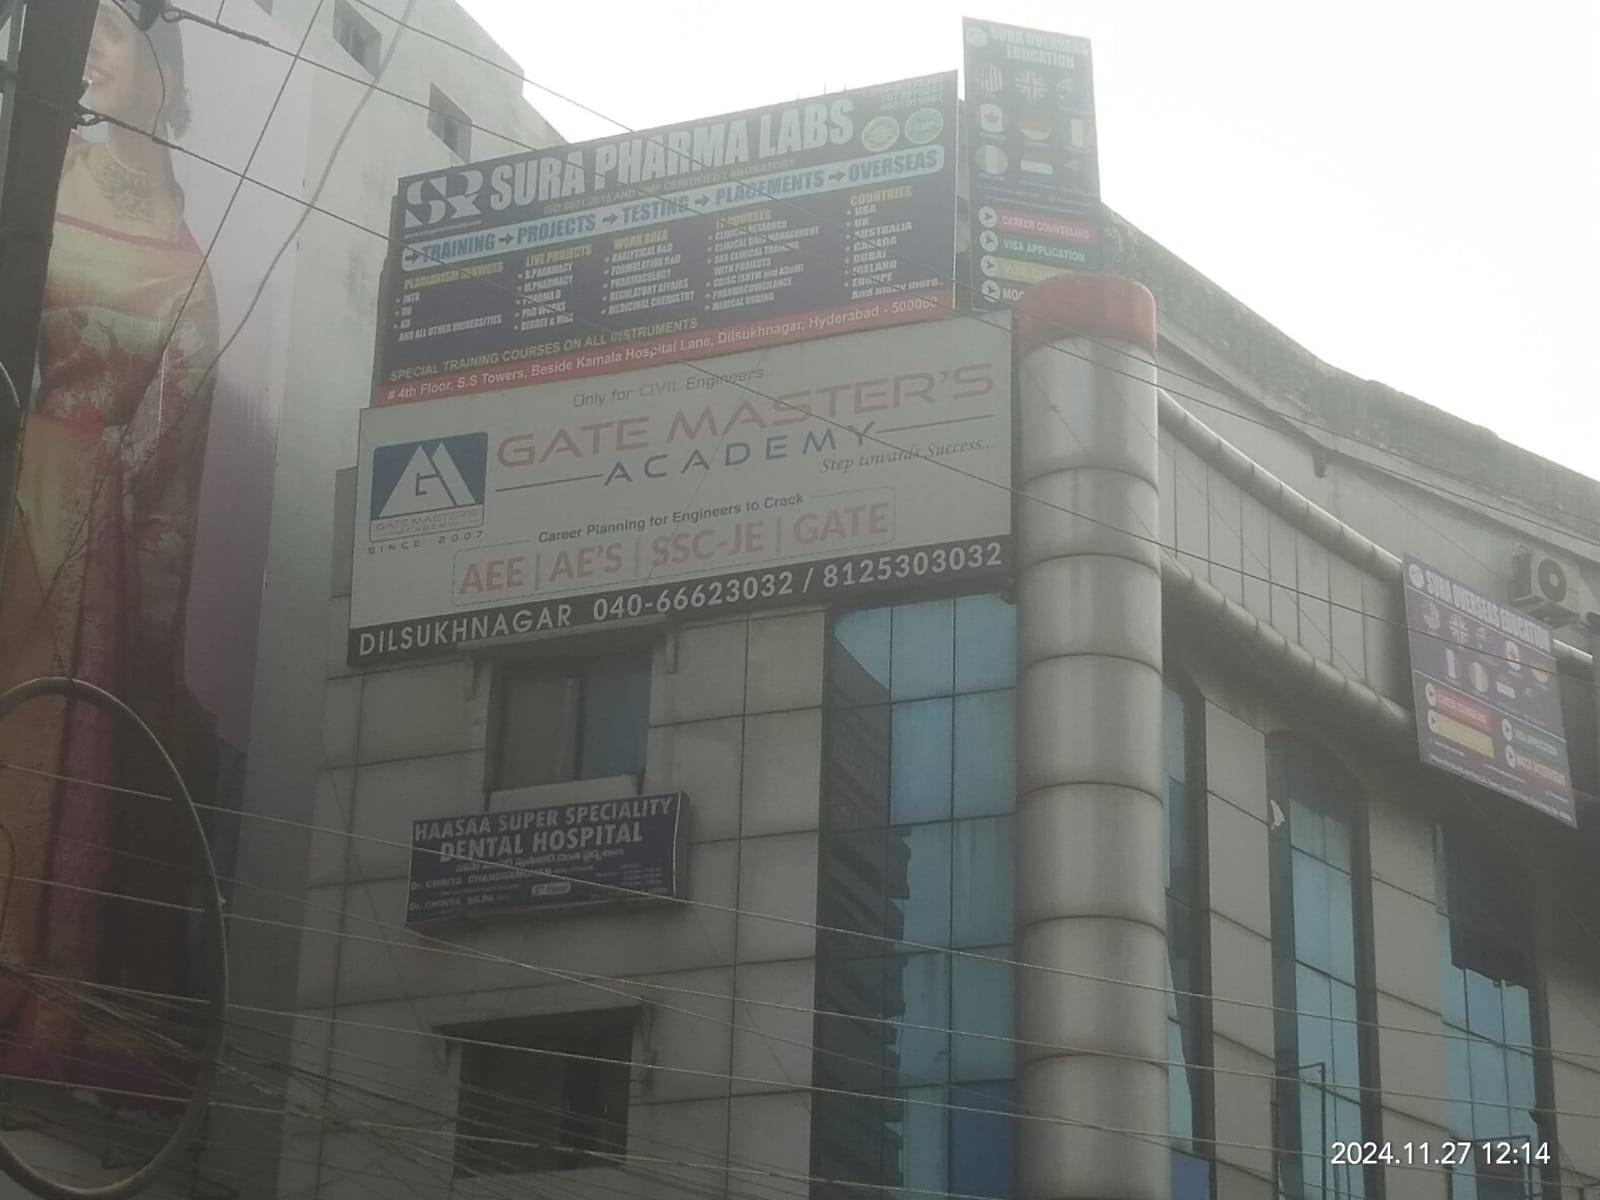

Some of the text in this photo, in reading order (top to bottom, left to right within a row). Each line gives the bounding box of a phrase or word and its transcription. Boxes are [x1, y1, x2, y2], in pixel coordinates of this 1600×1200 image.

[490, 151, 585, 210] SURA
[594, 119, 749, 192] PHARMA
[759, 98, 854, 158] LABS
[423, 233, 496, 263] TRAINING
[517, 213, 597, 246] PROJECTS
[623, 195, 689, 224] TESTING
[716, 169, 824, 206] PLACEMENTS
[849, 150, 937, 182] OVERSEAS
[850, 185, 912, 206] COUNTRIES
[855, 204, 876, 216] USA
[854, 221, 913, 239] AUSTRALIA
[855, 217, 869, 228] UK
[1002, 216, 1035, 230] CAREER
[853, 250, 886, 264] DUBAI
[1003, 239, 1085, 263] VISA APPLICATION
[1002, 287, 1025, 301] MOC
[390, 318, 698, 382] SPECIAL TRAINING COURSES ON ALL INSTRUMENTS
[457, 374, 478, 389] S.S
[482, 369, 528, 384] Towers,
[530, 360, 573, 376] Beside
[577, 352, 623, 369] Kamala
[625, 340, 677, 362] Hospital
[718, 320, 806, 344] Dilsukhnagar,
[809, 304, 880, 329] Hyderabad
[573, 366, 765, 409] Only for CIVIL Engineers
[497, 361, 995, 469] GATE MASTER'S
[603, 420, 877, 487] ACADEMY
[821, 457, 854, 474] Step
[858, 444, 922, 466] towards
[538, 493, 804, 544] Career Planning for Engineers to Crack
[367, 530, 484, 555] SINCE 2007
[459, 502, 889, 594] AEE AE'S SSC-JE GATE
[359, 542, 1003, 656] DILSUKHNAGAR 040-66623032 / 8125303032
[415, 798, 673, 841] HAASAA SUPER SPECIALITY
[440, 833, 524, 863] DENTAL
[532, 821, 643, 853] HOSPITAL
